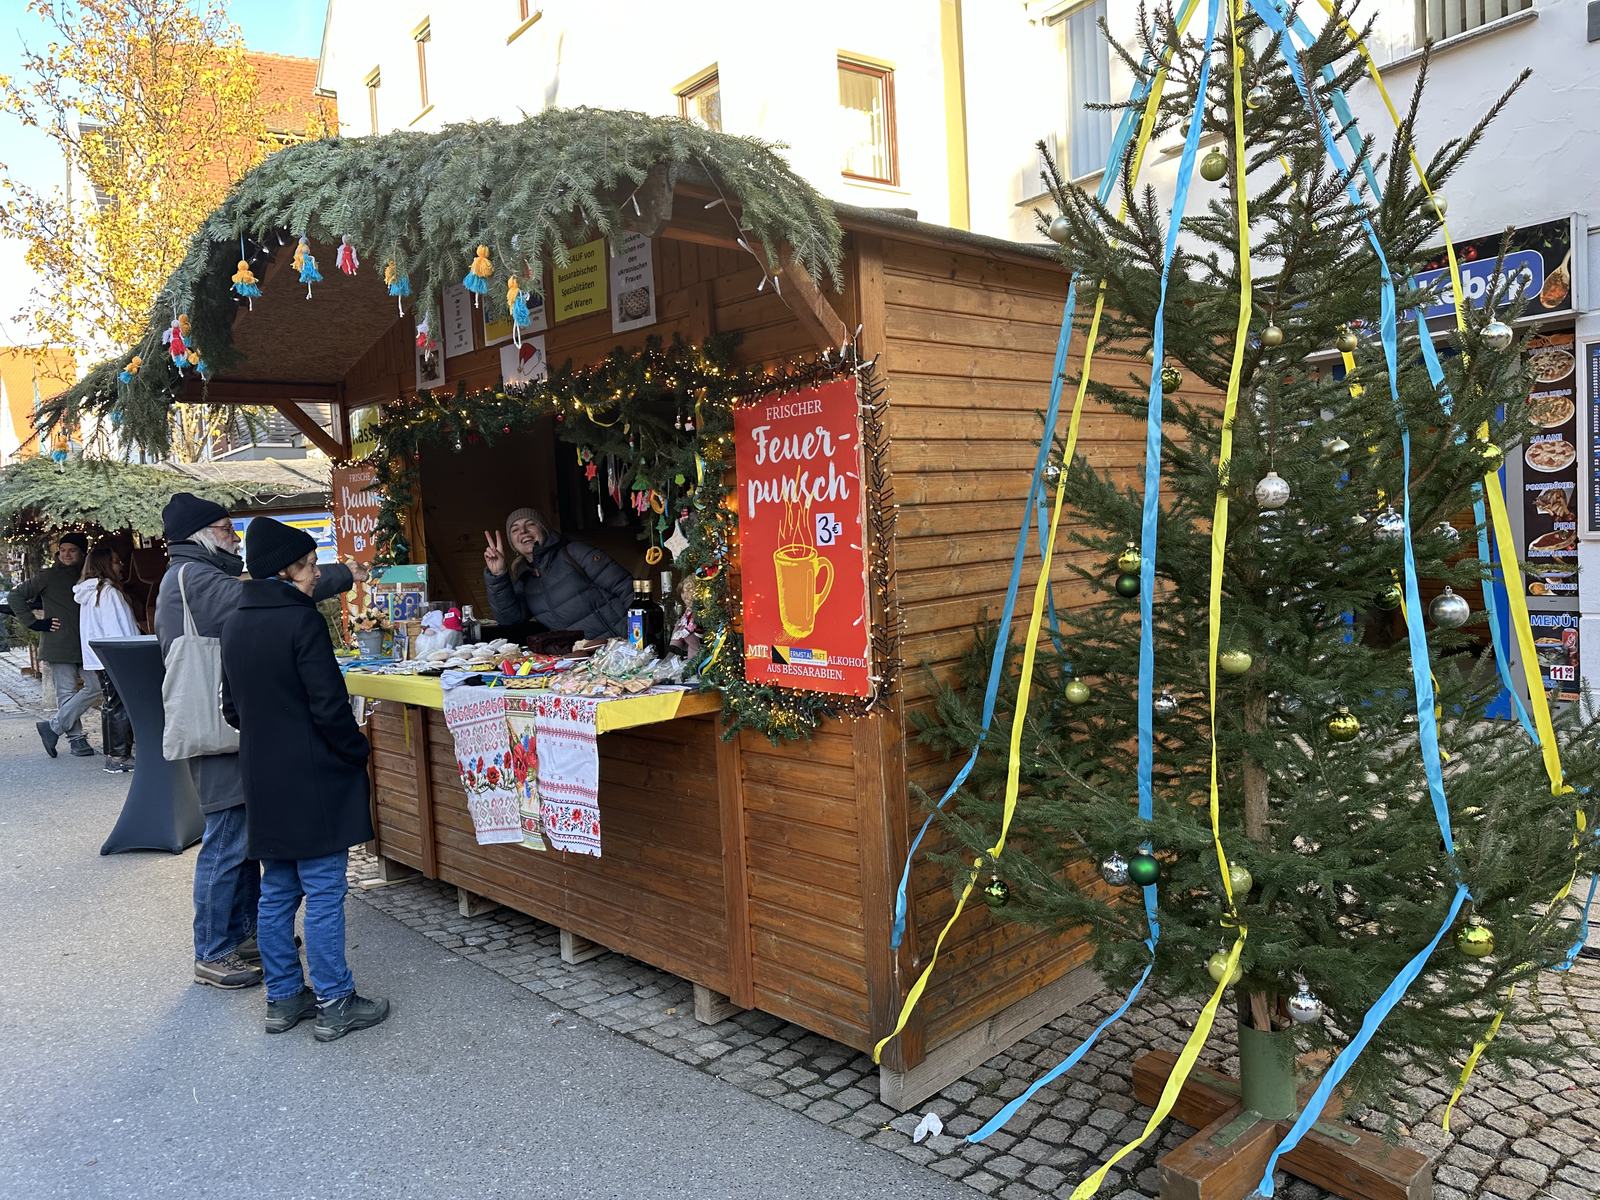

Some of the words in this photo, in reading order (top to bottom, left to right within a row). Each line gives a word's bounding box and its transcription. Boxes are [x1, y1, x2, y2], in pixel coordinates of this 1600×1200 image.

[584, 250, 595, 259] von
[558, 264, 598, 283] Bessarabischen
[561, 280, 595, 297] Spezialitäten
[563, 302, 573, 312] und
[574, 298, 593, 309] Waren
[766, 399, 823, 421] FRISCHER
[751, 425, 851, 466] Feuer-
[747, 460, 850, 520] punsch
[818, 515, 840, 544] 3€
[747, 644, 769, 658] MIT
[827, 656, 867, 668] ALKOHOL
[766, 664, 781, 673] AUS
[782, 664, 846, 680] BESSARABIEN.
[1551, 666, 1563, 679] 11
